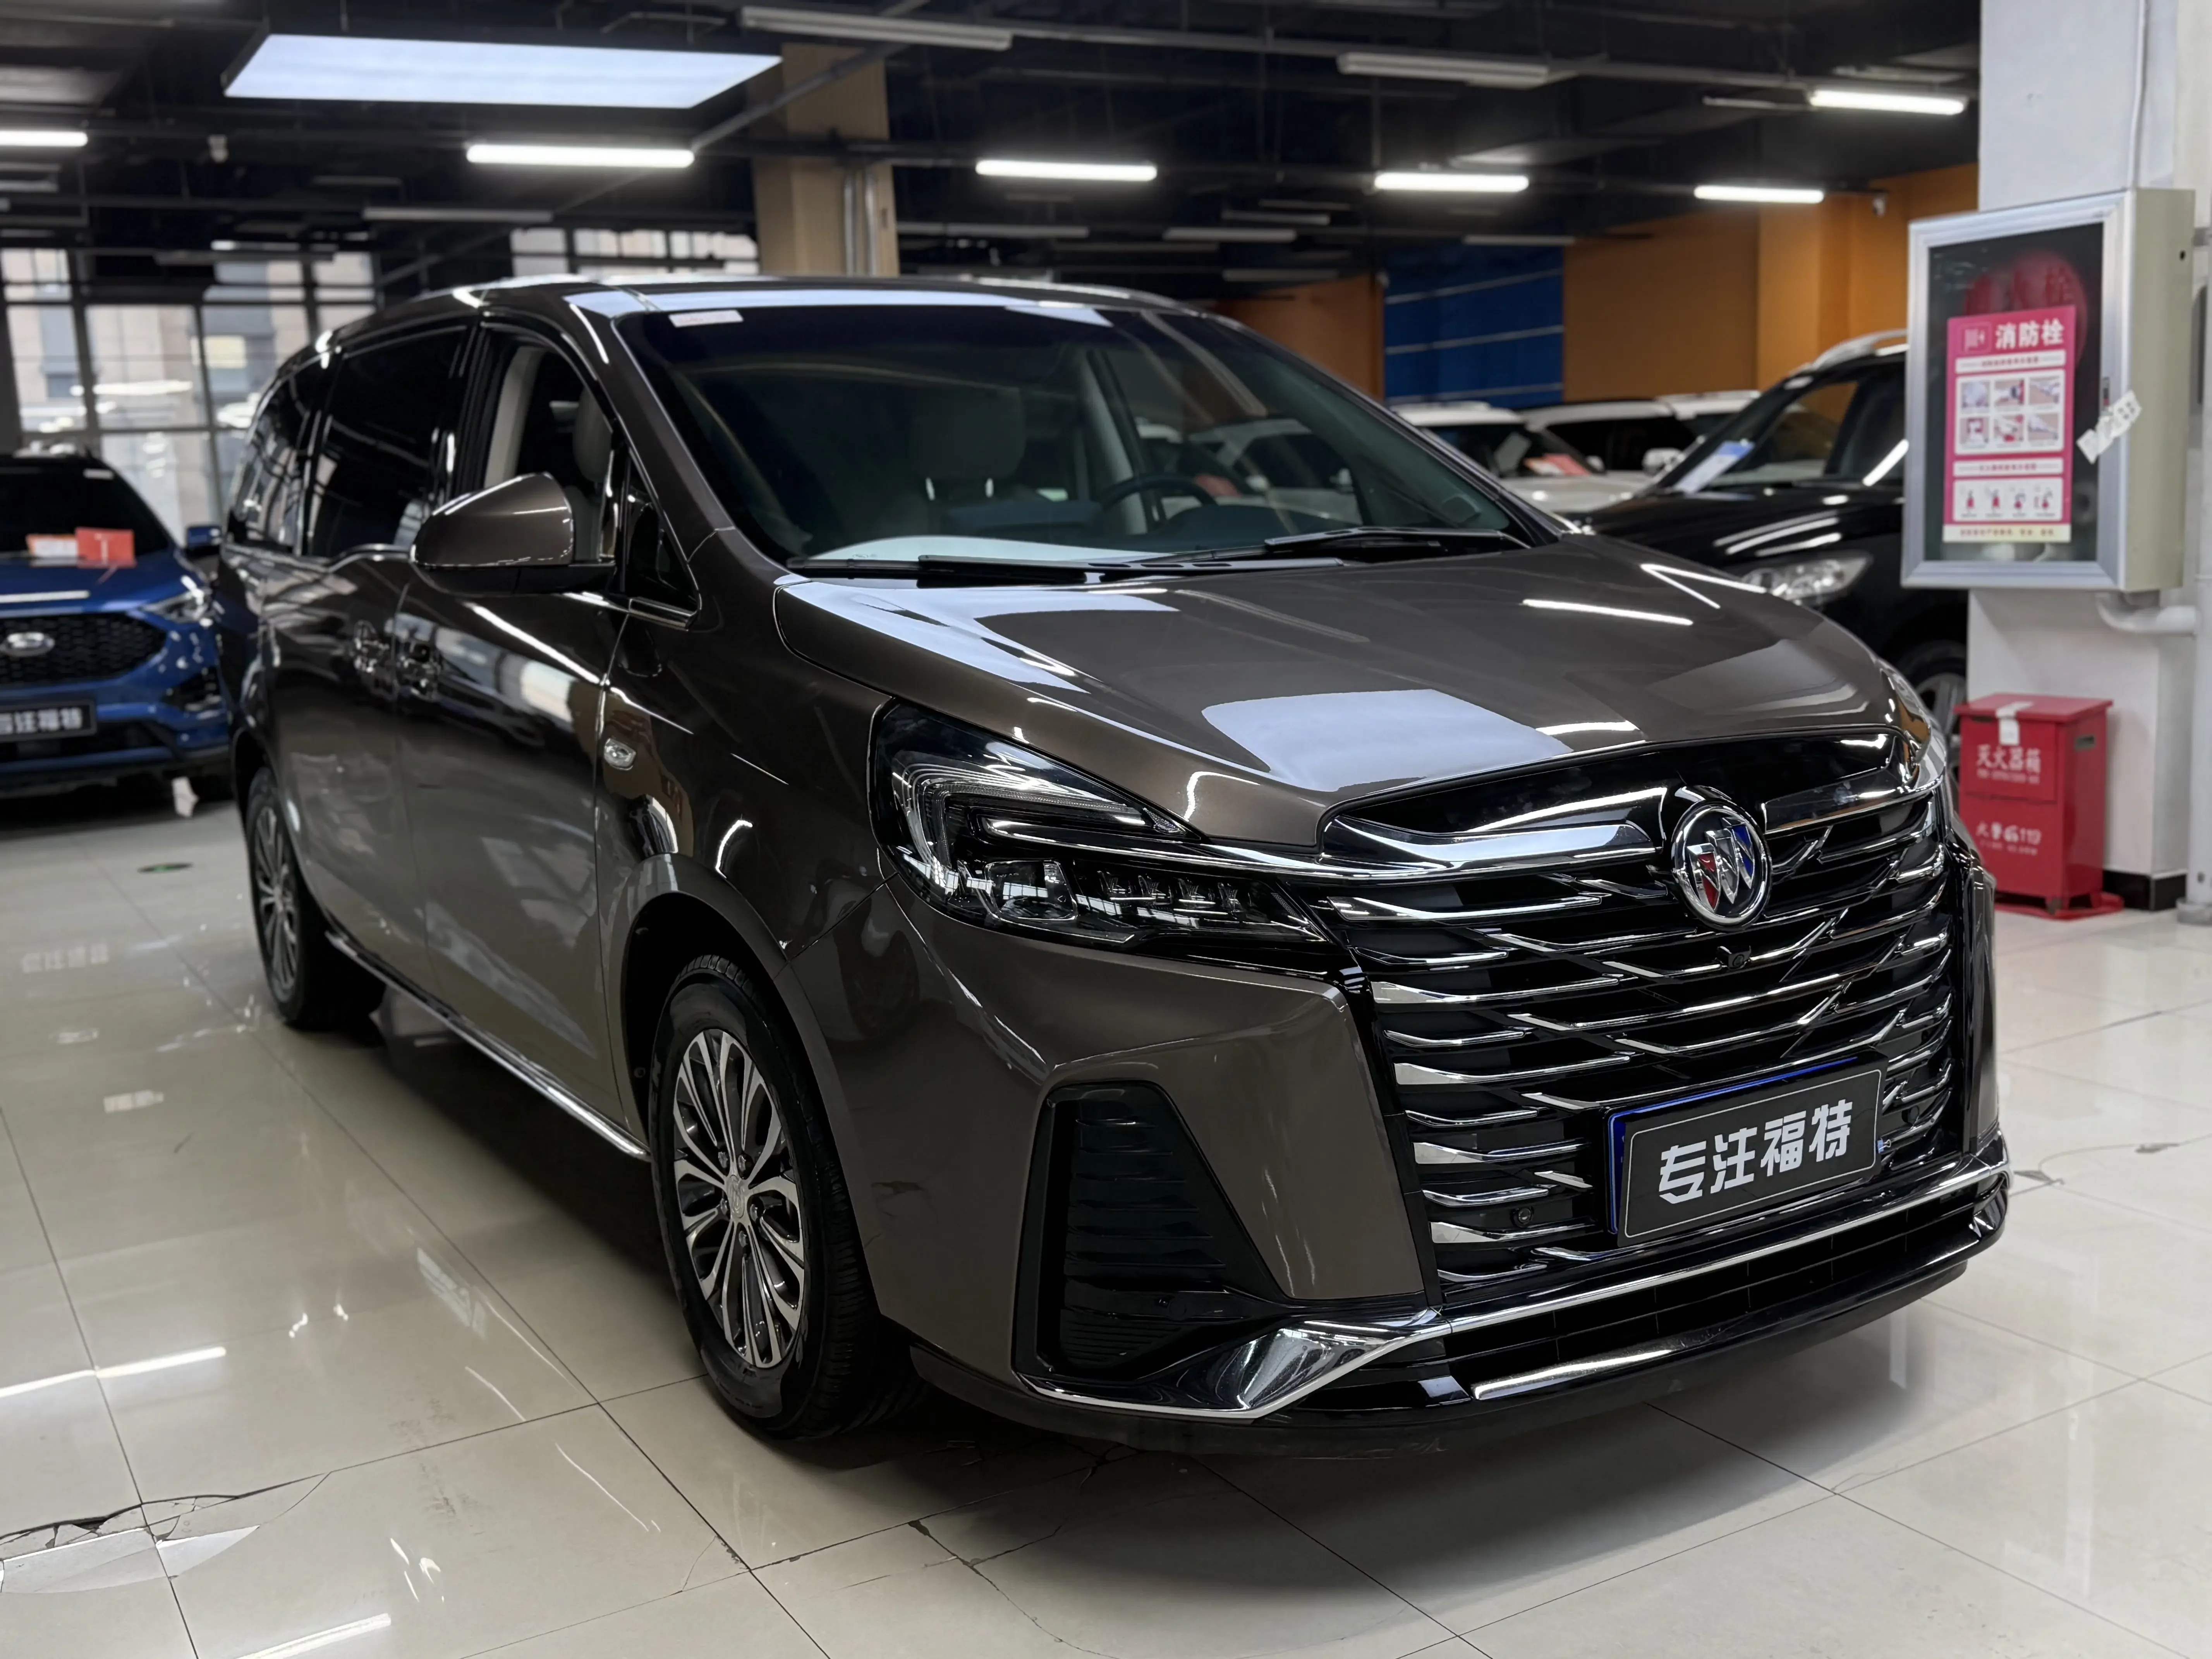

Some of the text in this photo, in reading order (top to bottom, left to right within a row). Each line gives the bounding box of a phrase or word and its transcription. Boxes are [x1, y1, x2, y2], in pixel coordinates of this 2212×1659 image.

[1996, 318, 2064, 349] 消防栓
[1659, 1099, 1853, 1204] 专注福特
